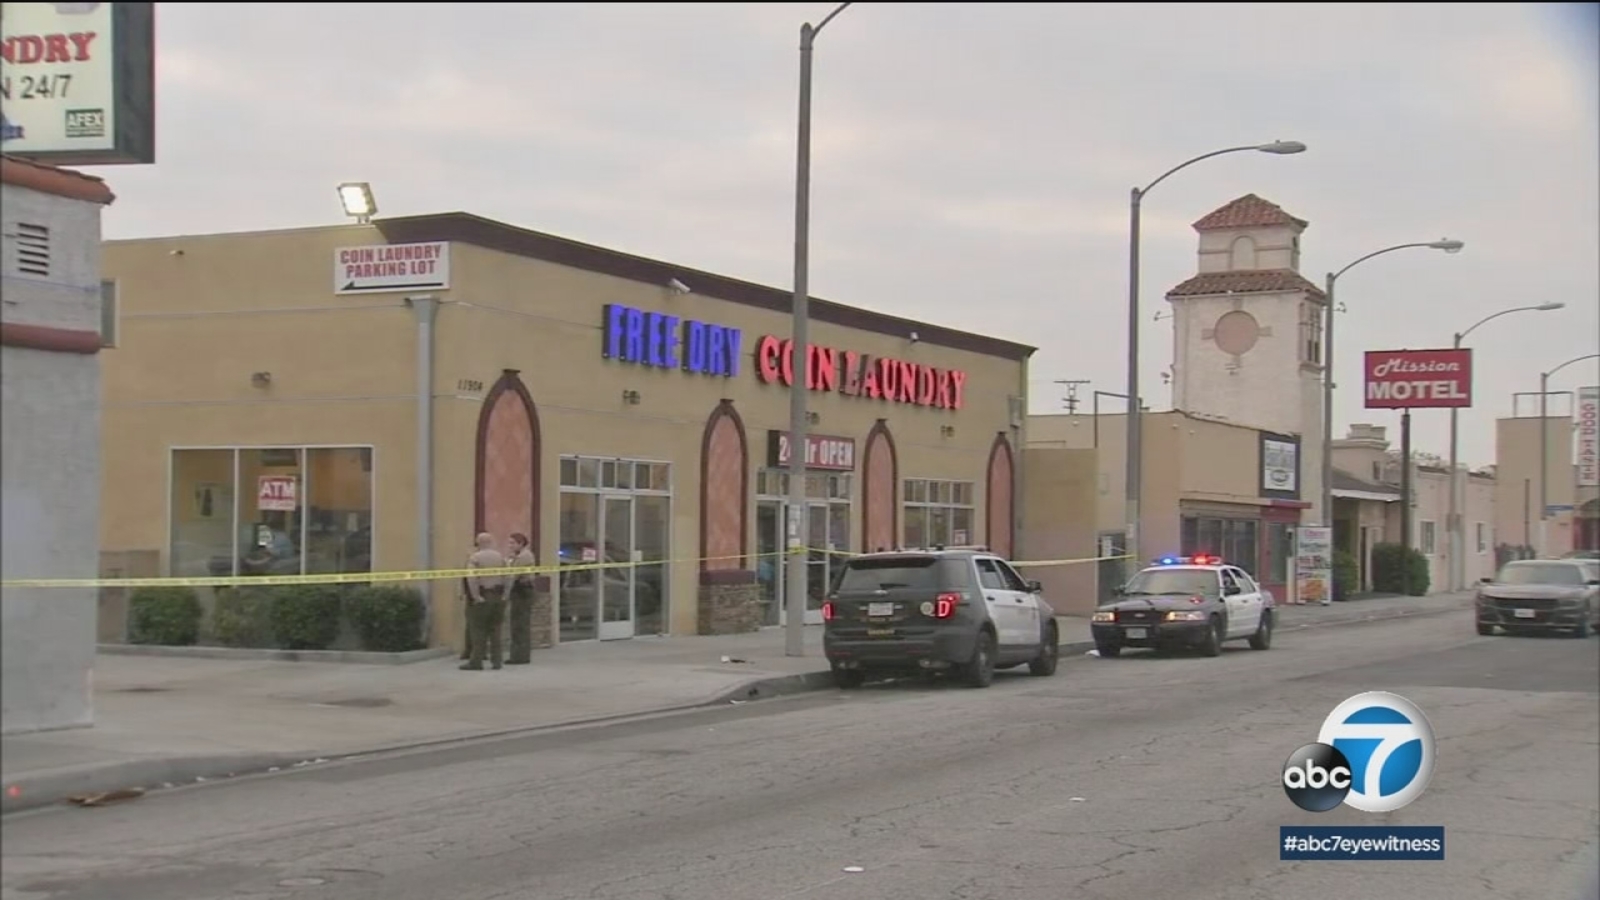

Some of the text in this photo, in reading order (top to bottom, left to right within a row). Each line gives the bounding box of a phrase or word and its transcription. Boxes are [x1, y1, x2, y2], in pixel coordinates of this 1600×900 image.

[20, 74, 72, 99] 24/7
[341, 244, 442, 264] COIN LAUNDRY
[346, 259, 435, 278] PARKING LOT
[602, 303, 680, 368] FREE
[682, 319, 741, 377] DRY
[840, 350, 965, 409] LAUNDRY
[1373, 358, 1460, 377] Mission
[1368, 380, 1467, 399] MOTEL
[1581, 403, 1596, 435] GOOD
[820, 440, 853, 466] OPEN
[260, 481, 296, 498] ATM
